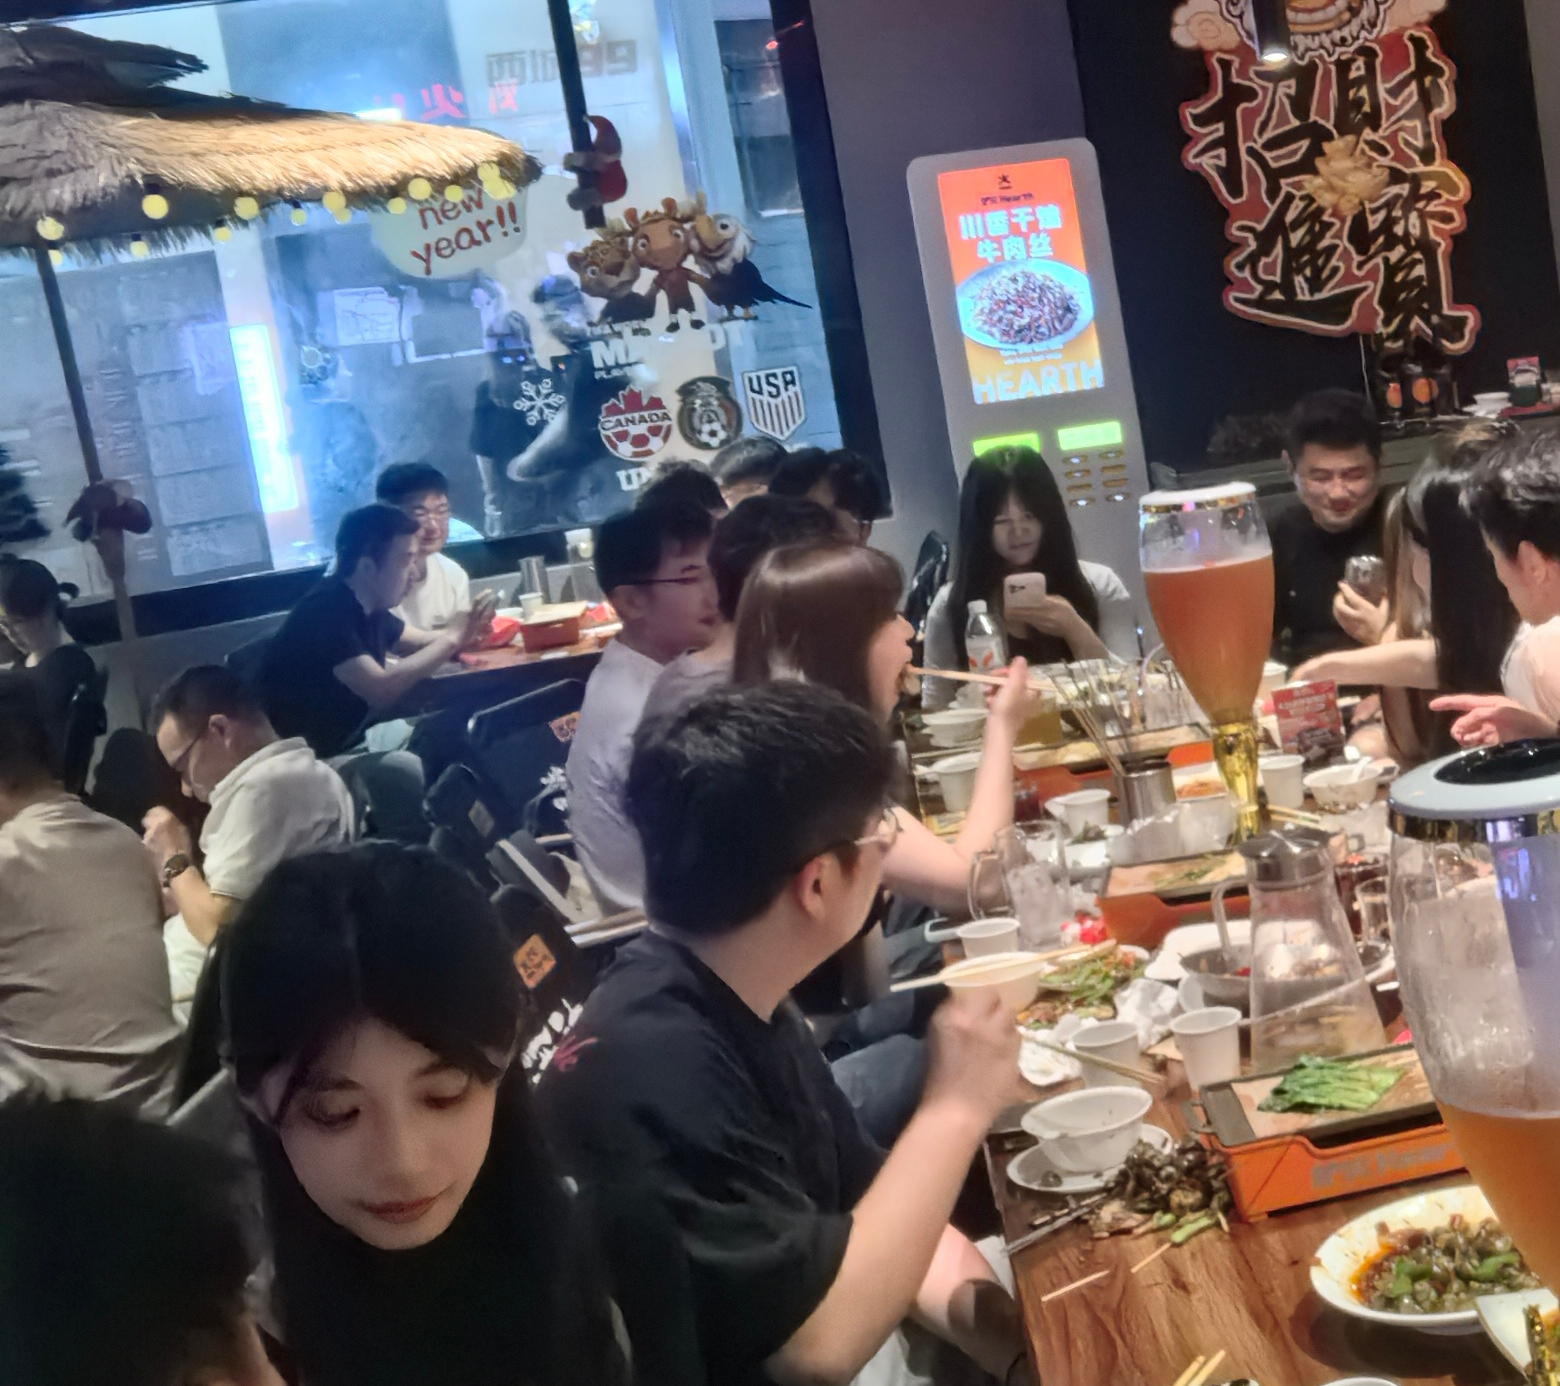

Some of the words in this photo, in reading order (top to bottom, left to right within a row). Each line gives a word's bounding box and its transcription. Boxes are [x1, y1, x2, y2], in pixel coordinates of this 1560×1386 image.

[418, 186, 485, 230] new
[410, 200, 521, 276] year!!
[747, 368, 798, 400] USA
[972, 358, 1105, 405] HEARTH
[600, 408, 672, 433] CANADA
